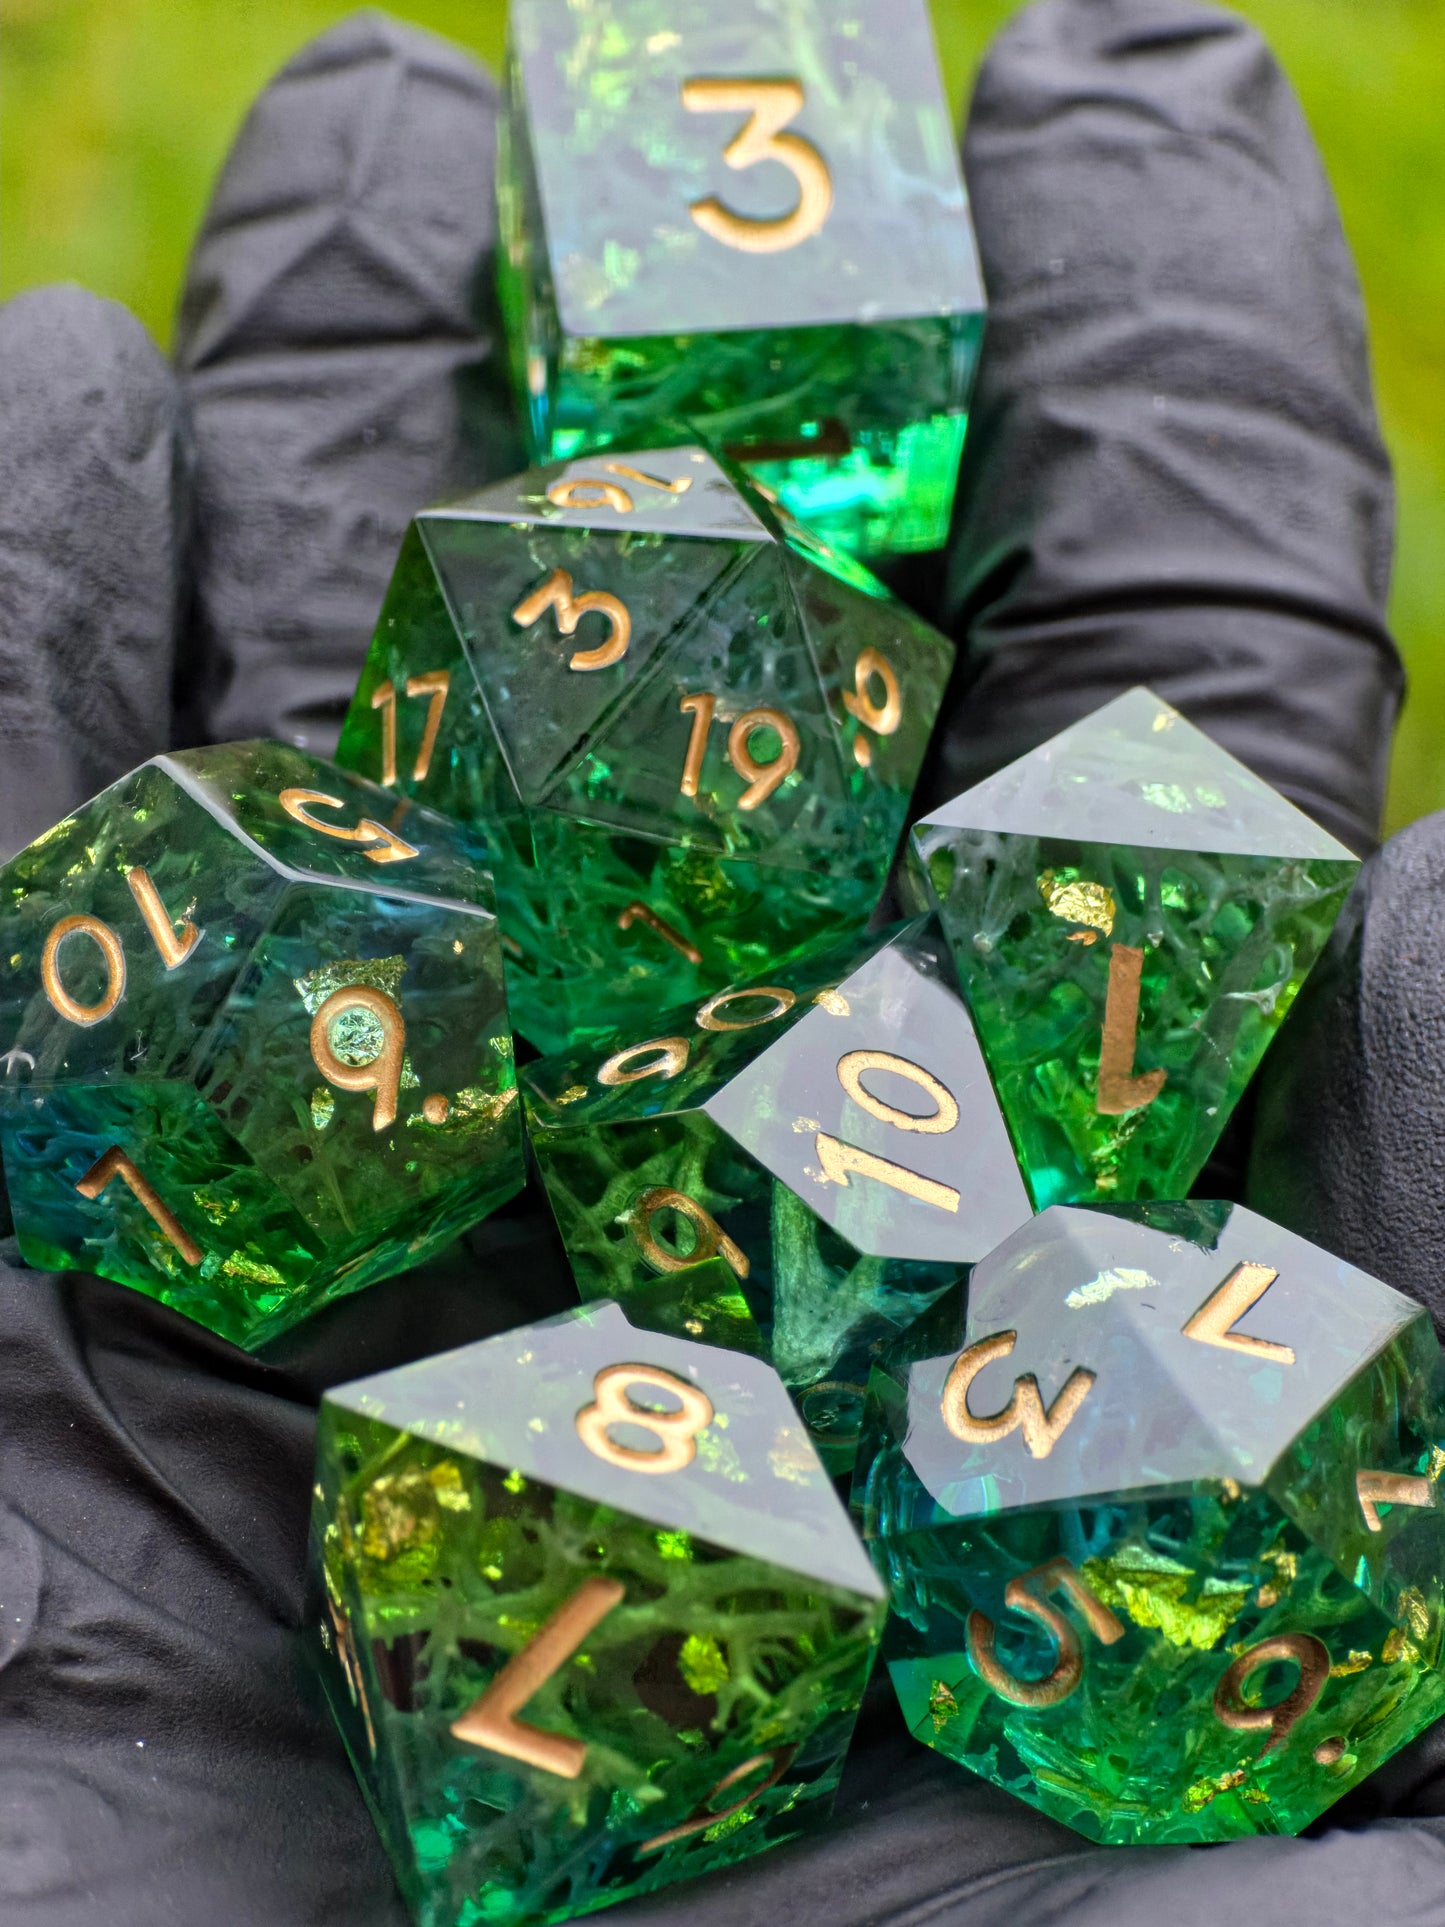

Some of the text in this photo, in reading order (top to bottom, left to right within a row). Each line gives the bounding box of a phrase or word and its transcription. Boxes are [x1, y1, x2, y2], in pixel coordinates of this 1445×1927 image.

[682, 79, 832, 253] 3
[513, 568, 631, 671] 3
[372, 670, 450, 787] 17
[680, 692, 800, 810] 19
[41, 866, 205, 1027] 10
[1097, 943, 1167, 1115] 1
[816, 1049, 961, 1213] 10
[575, 1362, 714, 1473] 8
[941, 1330, 1097, 1459] 3
[451, 1576, 625, 1779] 7
[967, 1556, 1126, 1707] 5
